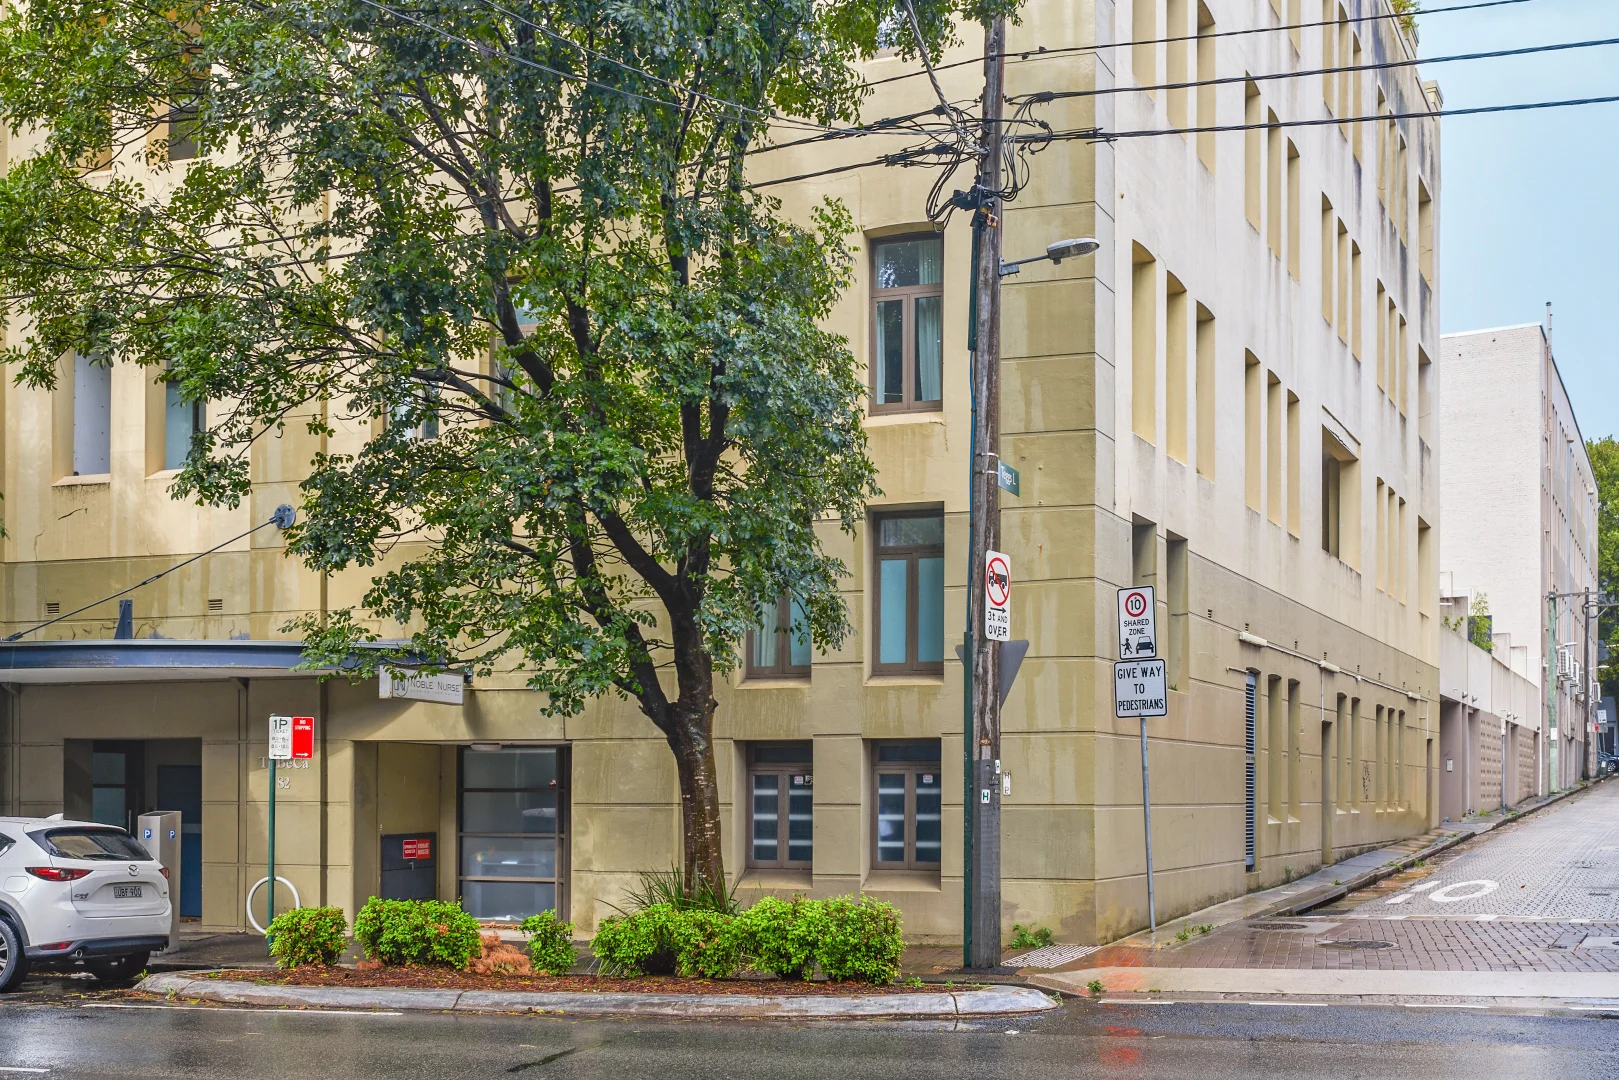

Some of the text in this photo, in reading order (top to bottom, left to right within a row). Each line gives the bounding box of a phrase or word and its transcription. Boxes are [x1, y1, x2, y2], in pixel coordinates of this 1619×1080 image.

[1001, 466, 1012, 485] Teggs
[1130, 599, 1141, 610] 10
[988, 611, 995, 621] 3t
[1124, 619, 1149, 627] SHARED
[988, 625, 1007, 636] OVER
[1118, 666, 1161, 679] GIVE WAY
[410, 680, 433, 690] NOBLE
[1134, 684, 1145, 694] TO
[1118, 699, 1163, 711] PEDESTRIANS
[273, 719, 288, 729] 1P
[258, 757, 309, 769] TBeCa
[278, 777, 290, 789] 82
[982, 792, 989, 800] H
